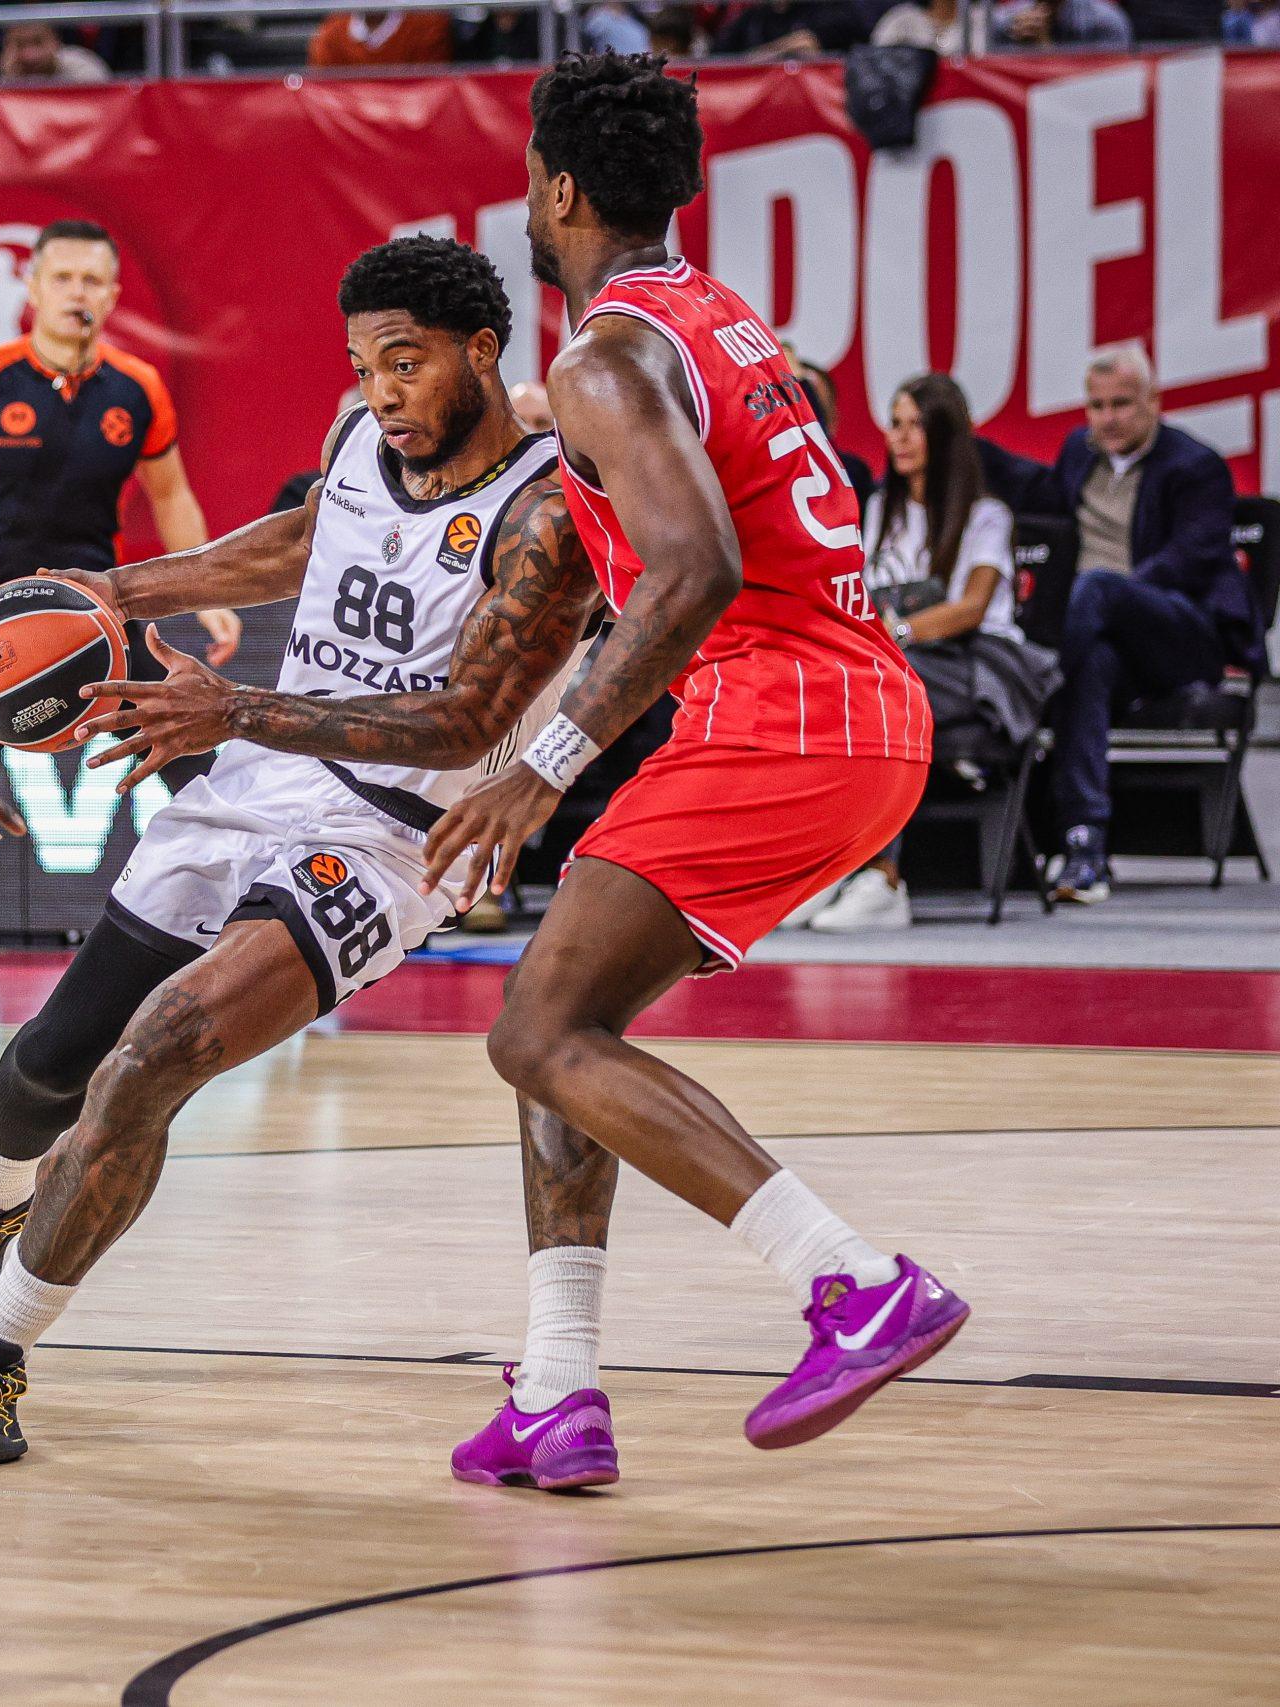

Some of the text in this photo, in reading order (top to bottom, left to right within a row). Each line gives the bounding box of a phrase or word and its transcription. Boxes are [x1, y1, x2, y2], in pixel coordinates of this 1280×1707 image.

[328, 493, 368, 520] AikBank
[333, 564, 415, 656] 88
[287, 627, 450, 693] MOZZART
[12, 699, 68, 734] LEGACY
[310, 876, 393, 979] 88
